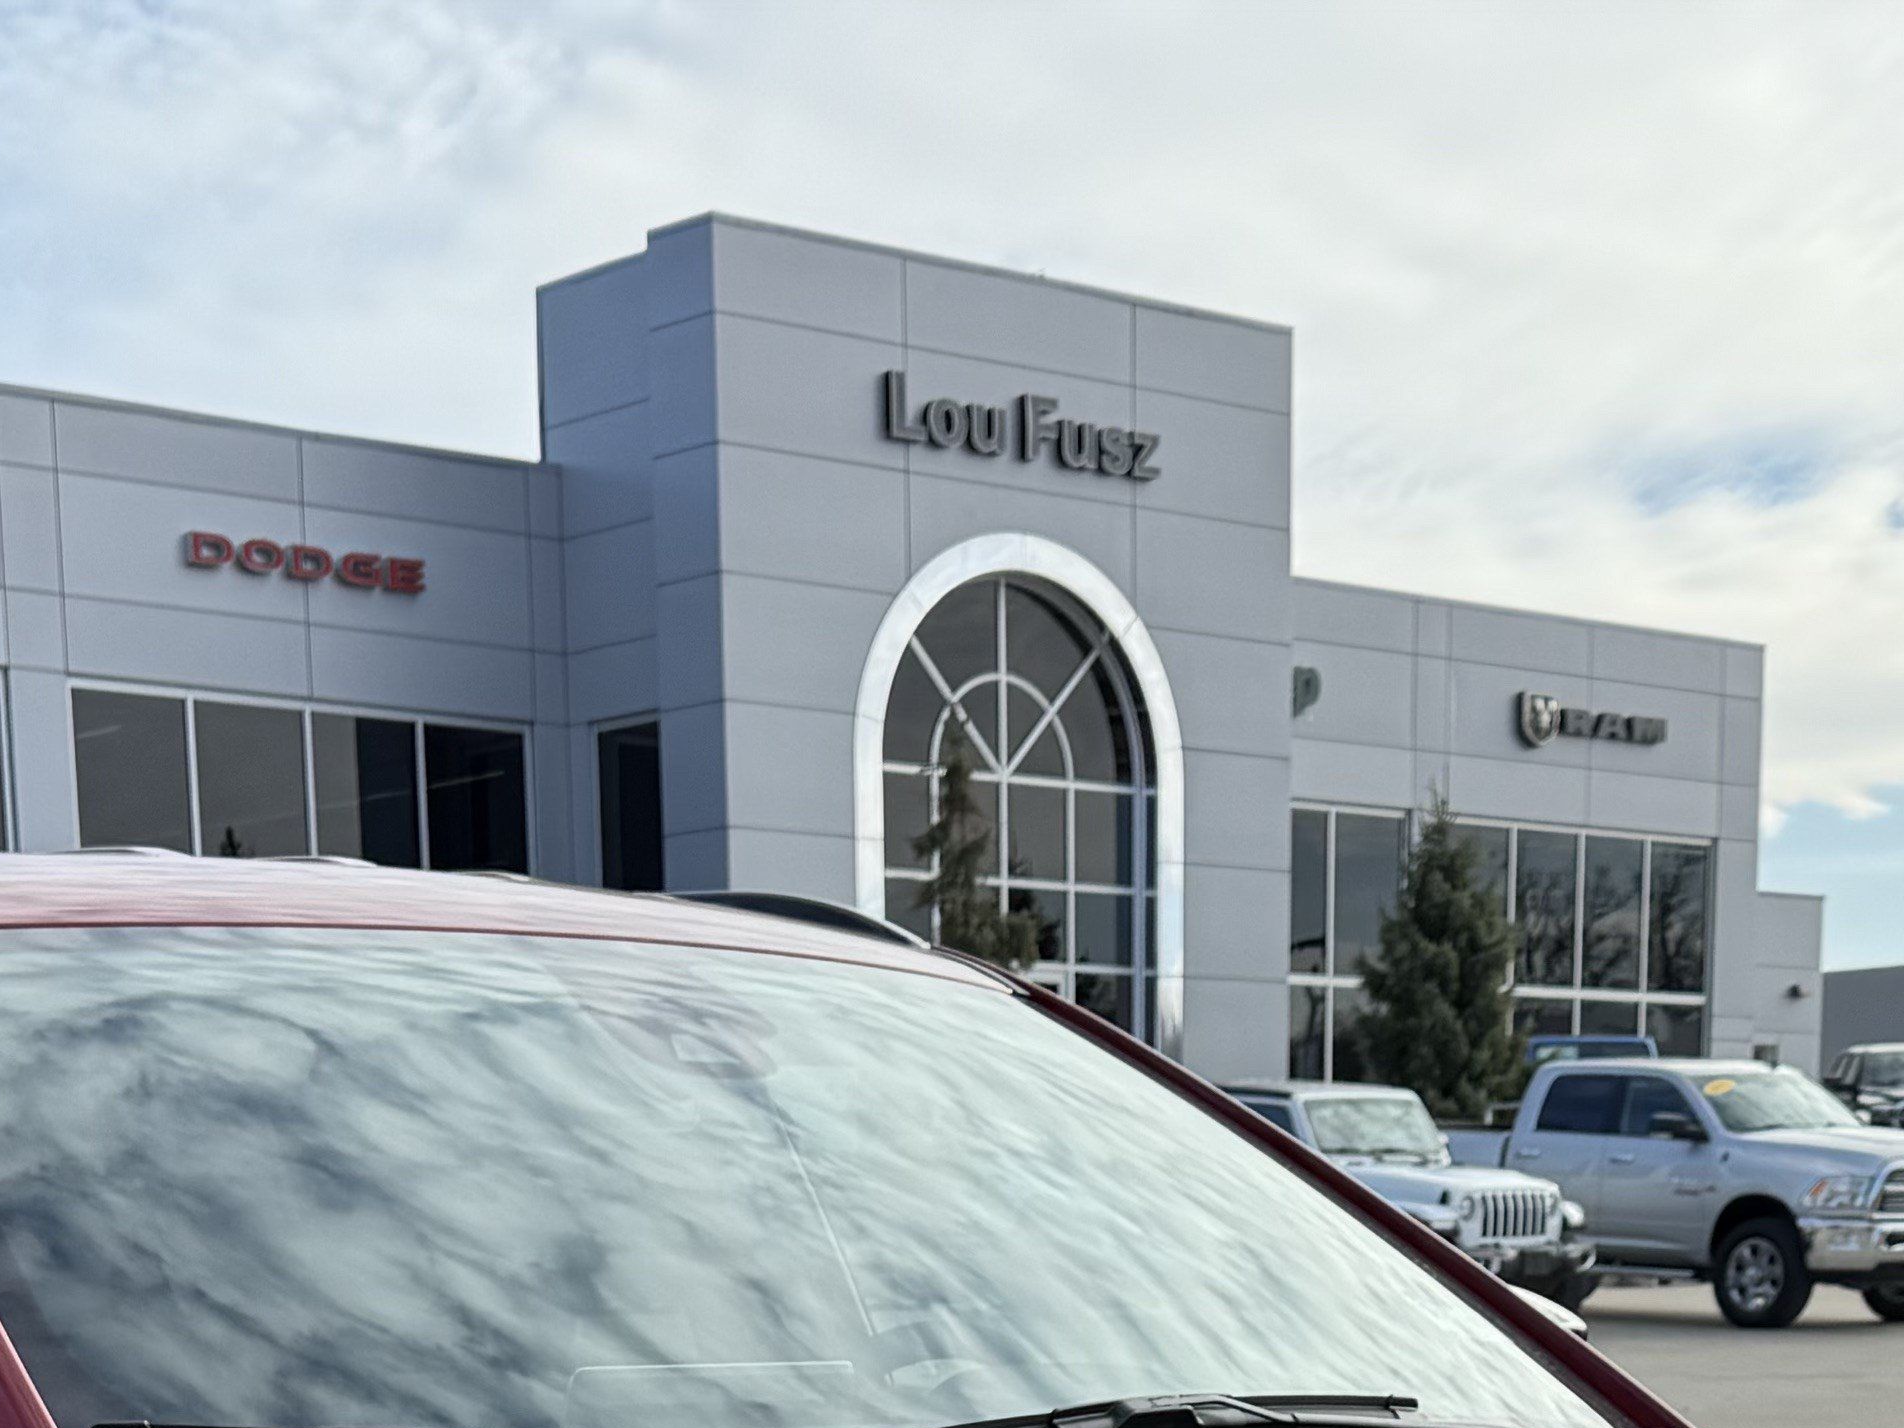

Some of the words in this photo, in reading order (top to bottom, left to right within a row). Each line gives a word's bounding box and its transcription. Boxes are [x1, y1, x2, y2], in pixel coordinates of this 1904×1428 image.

[881, 369, 1008, 457] Lou
[1016, 392, 1164, 482] Fusz
[184, 530, 427, 594] DODGE
[1559, 708, 1670, 746] RAM
